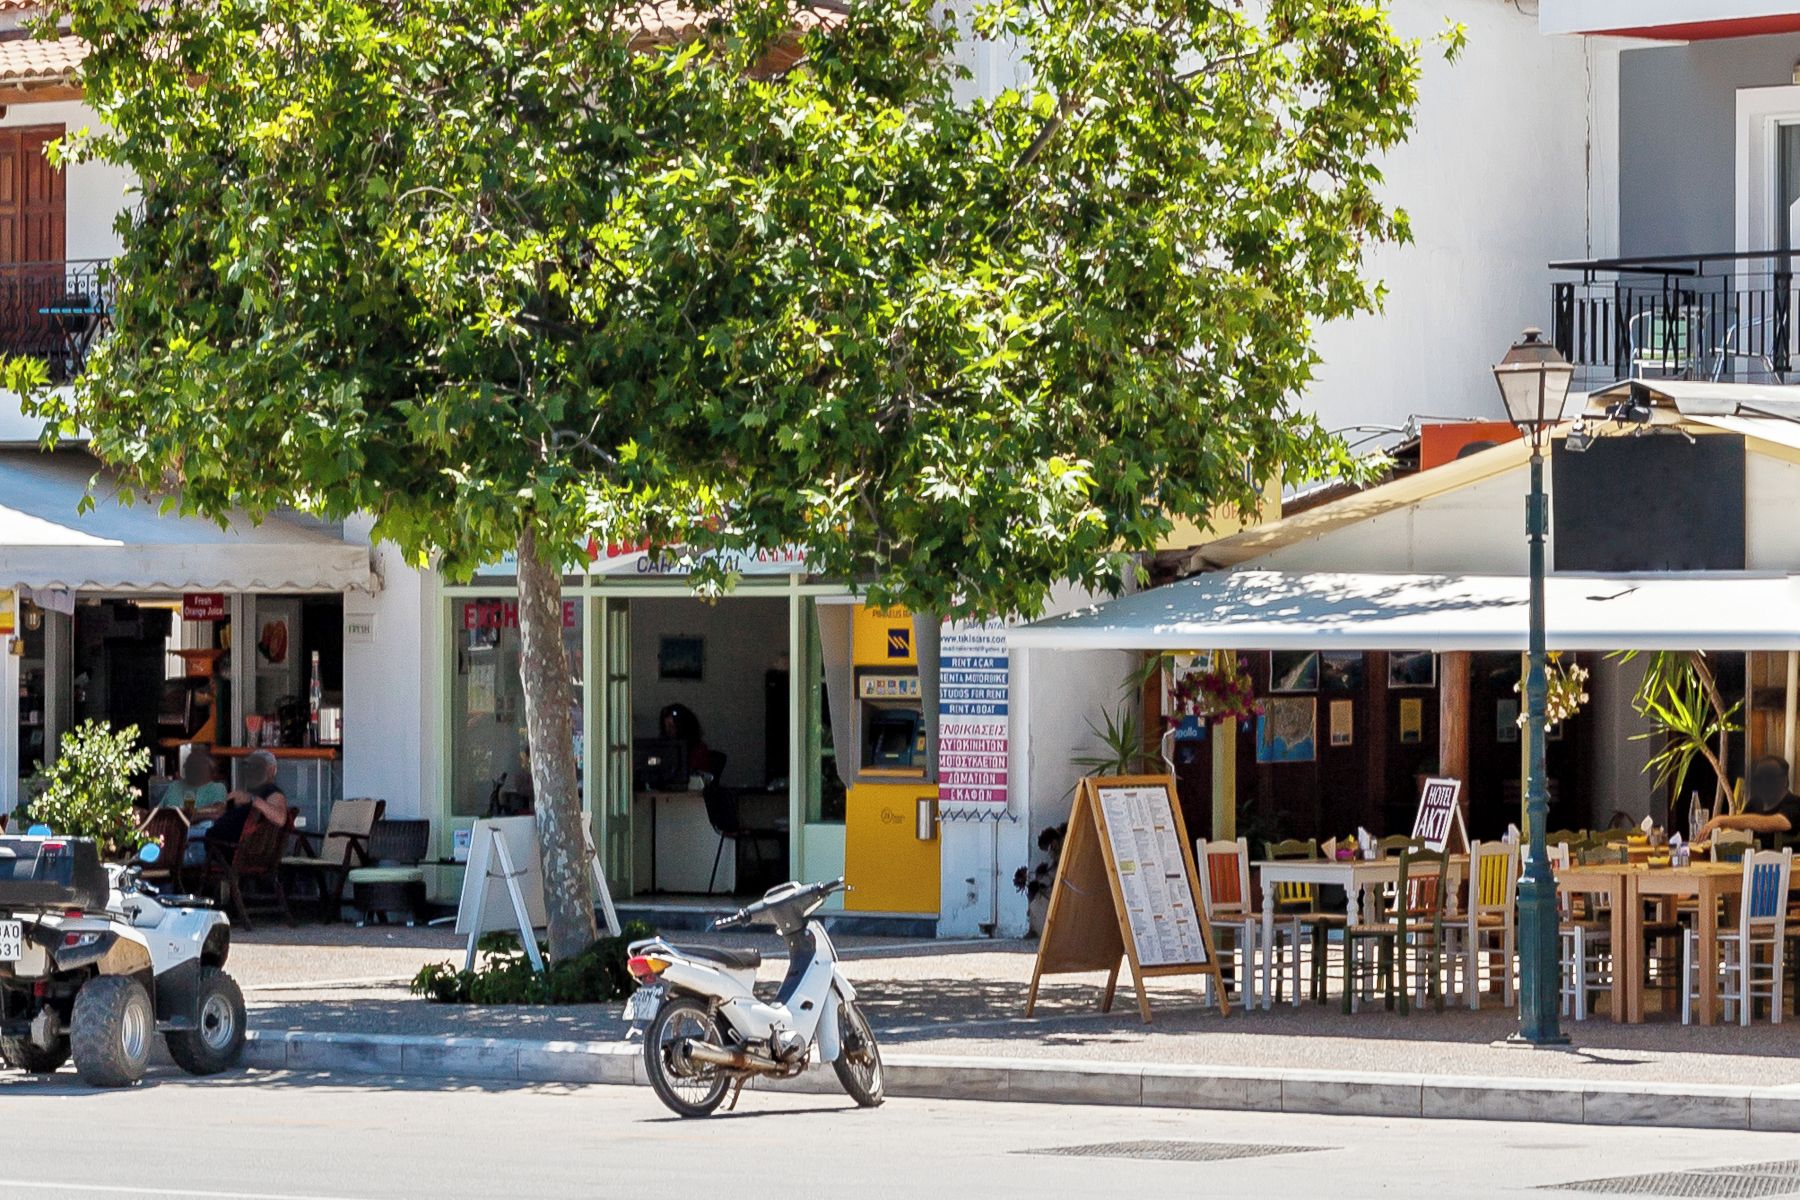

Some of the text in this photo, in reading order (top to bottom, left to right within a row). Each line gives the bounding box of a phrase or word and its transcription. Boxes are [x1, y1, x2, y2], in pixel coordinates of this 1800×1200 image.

[194, 595, 212, 606] Fresh
[184, 606, 206, 618] Orange
[464, 601, 575, 629] EXCHE
[951, 657, 972, 668] RENT
[978, 657, 994, 668] CAR
[964, 673, 1006, 684] MOTORBIKE
[970, 688, 985, 699] FOR
[986, 688, 1006, 699] RENT
[949, 704, 970, 714] RENT
[976, 704, 995, 714] BOAT
[940, 740, 1004, 752] ΑΥΤΟΚΙΝΗΤΩΝ
[948, 772, 996, 784] ΔΩΜΑΤΙΩΝ
[950, 789, 993, 801] ΣΚΑΦΩΝ
[1427, 785, 1453, 807] HOTEL
[1416, 806, 1450, 840] AKTI
[0, 943, 20, 957] 31
